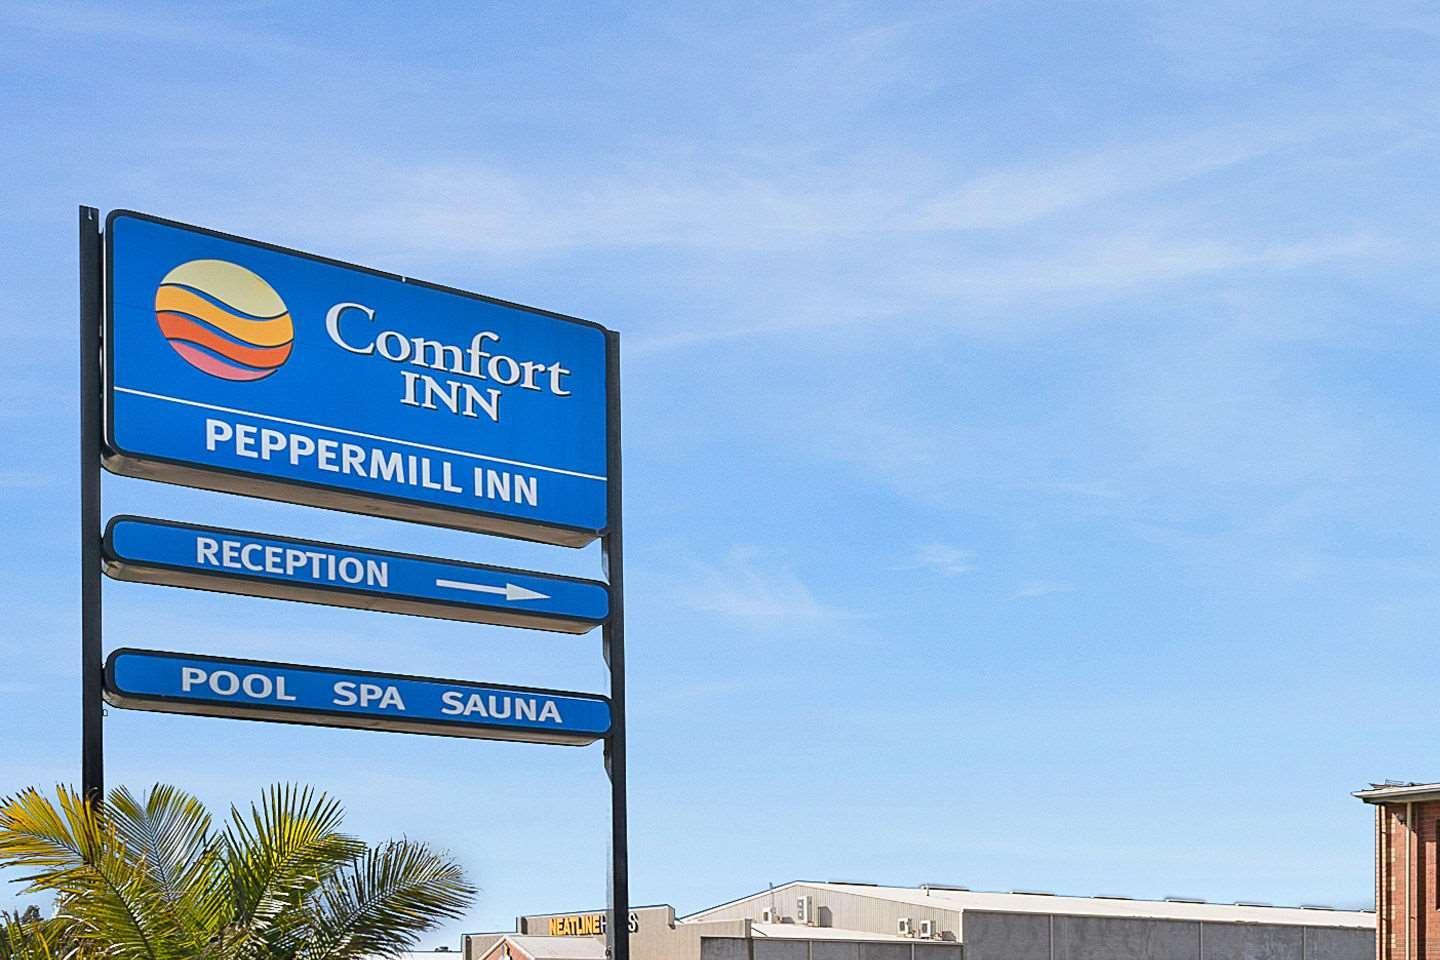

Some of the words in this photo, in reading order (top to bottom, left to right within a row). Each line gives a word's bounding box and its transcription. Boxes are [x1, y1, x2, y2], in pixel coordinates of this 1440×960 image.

[325, 302, 571, 397] Comfort
[400, 370, 501, 423] INN
[206, 418, 463, 494] PEPPERMILL
[474, 467, 538, 507] INN
[195, 537, 389, 588] RECEPTION
[181, 667, 296, 702] POOL
[332, 681, 406, 711] SPA
[440, 691, 563, 725] SAUNA
[548, 914, 601, 936] NEATLINE
